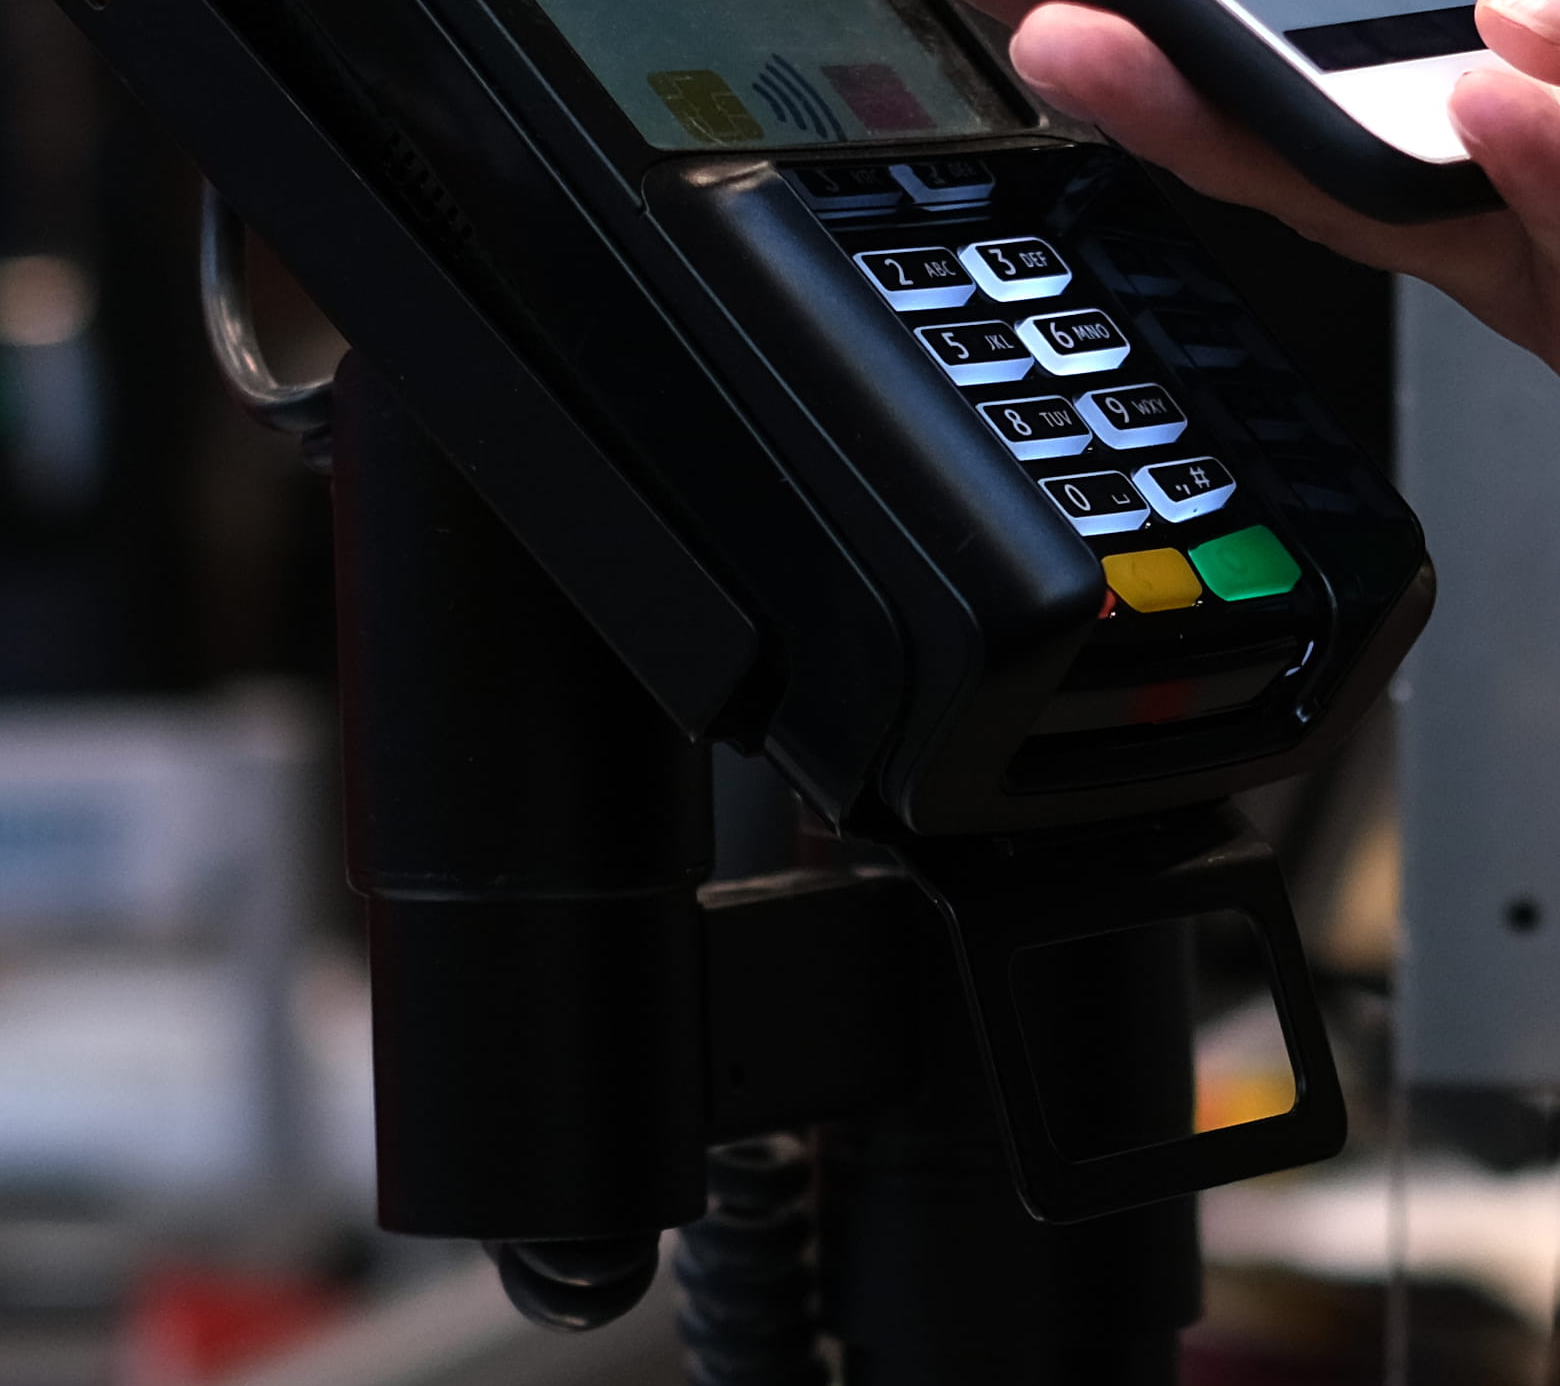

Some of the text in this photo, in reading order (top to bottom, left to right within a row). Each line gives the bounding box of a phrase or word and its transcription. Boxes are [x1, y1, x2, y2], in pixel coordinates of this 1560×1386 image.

[883, 257, 958, 287] 2 ABC
[987, 248, 1048, 276] 3 DEF
[940, 331, 1016, 360] 5 JKL
[1049, 321, 1111, 350] 6 MNO
[1002, 407, 1074, 437] 8 TUV
[1104, 396, 1131, 424] 9
[1063, 482, 1092, 512] 0
